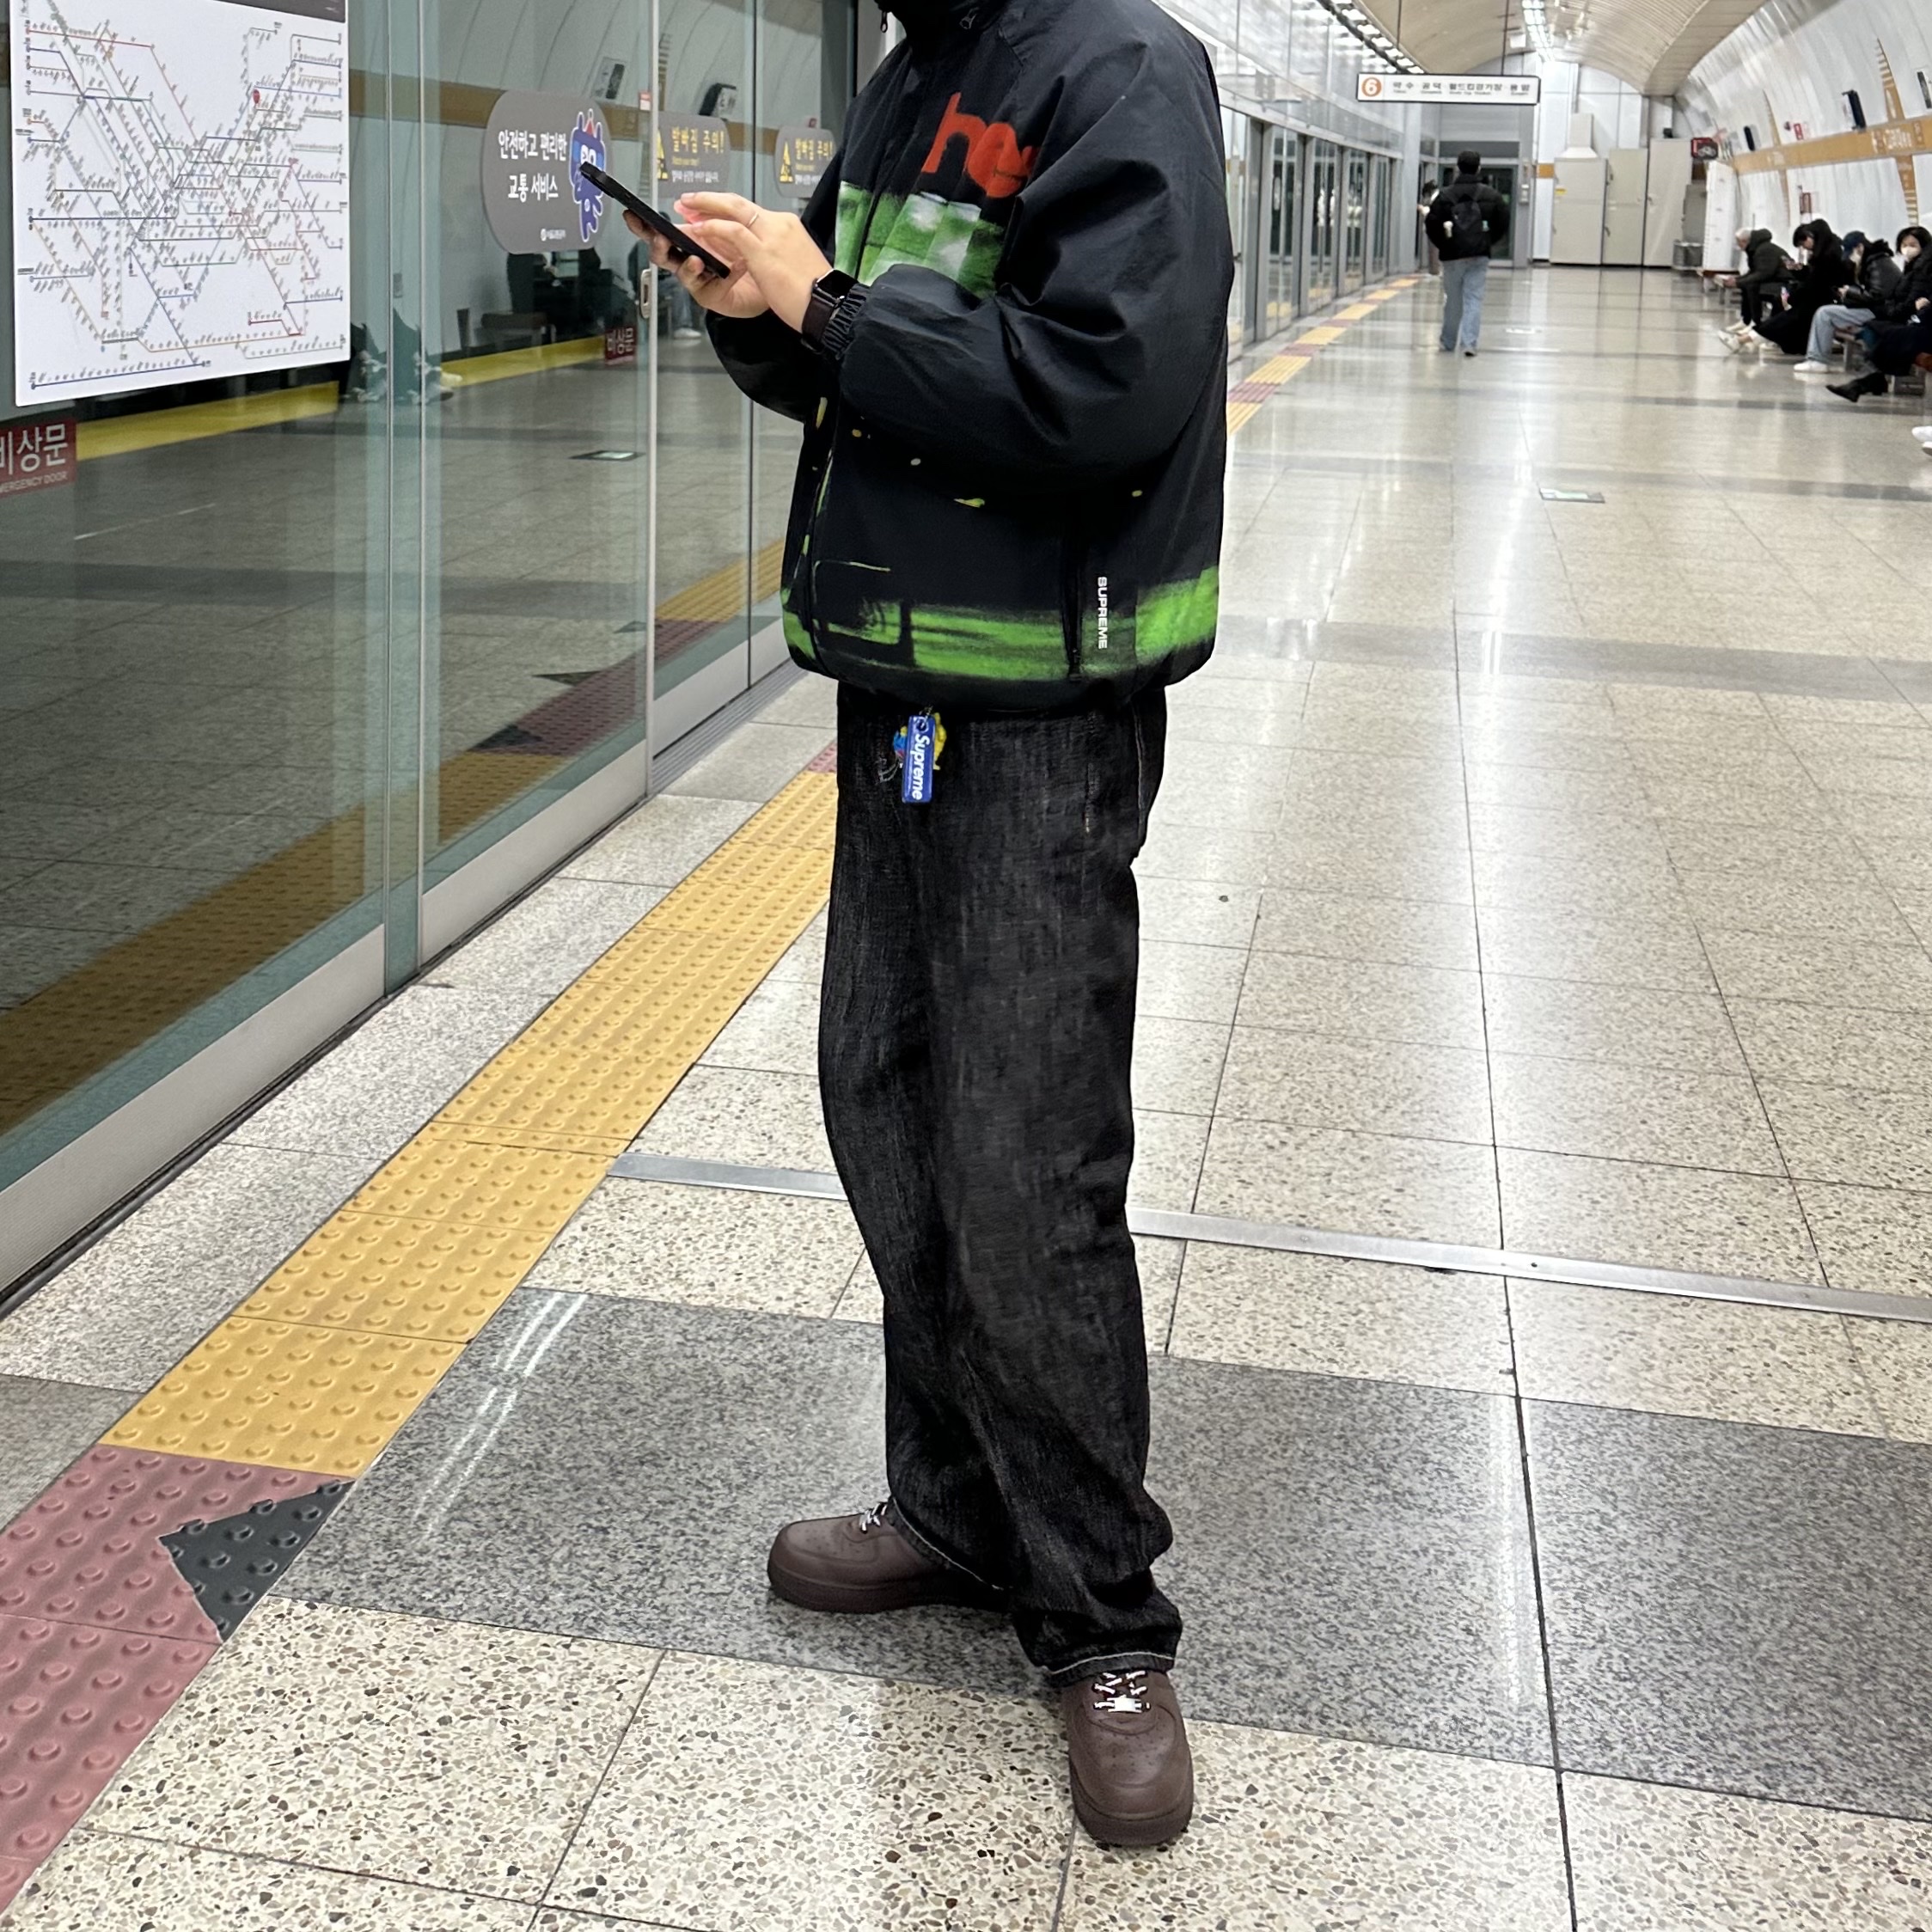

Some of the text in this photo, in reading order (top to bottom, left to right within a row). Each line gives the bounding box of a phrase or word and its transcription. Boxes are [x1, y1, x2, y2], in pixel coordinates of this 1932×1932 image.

[1364, 78, 1379, 96] 6
[498, 130, 567, 161] 안전하고 편리한
[672, 126, 724, 154] 발빠짐 주의!
[508, 173, 559, 203] 교통 서비스
[1097, 576, 1109, 649] SUPREME
[910, 734, 931, 800] Supreme
